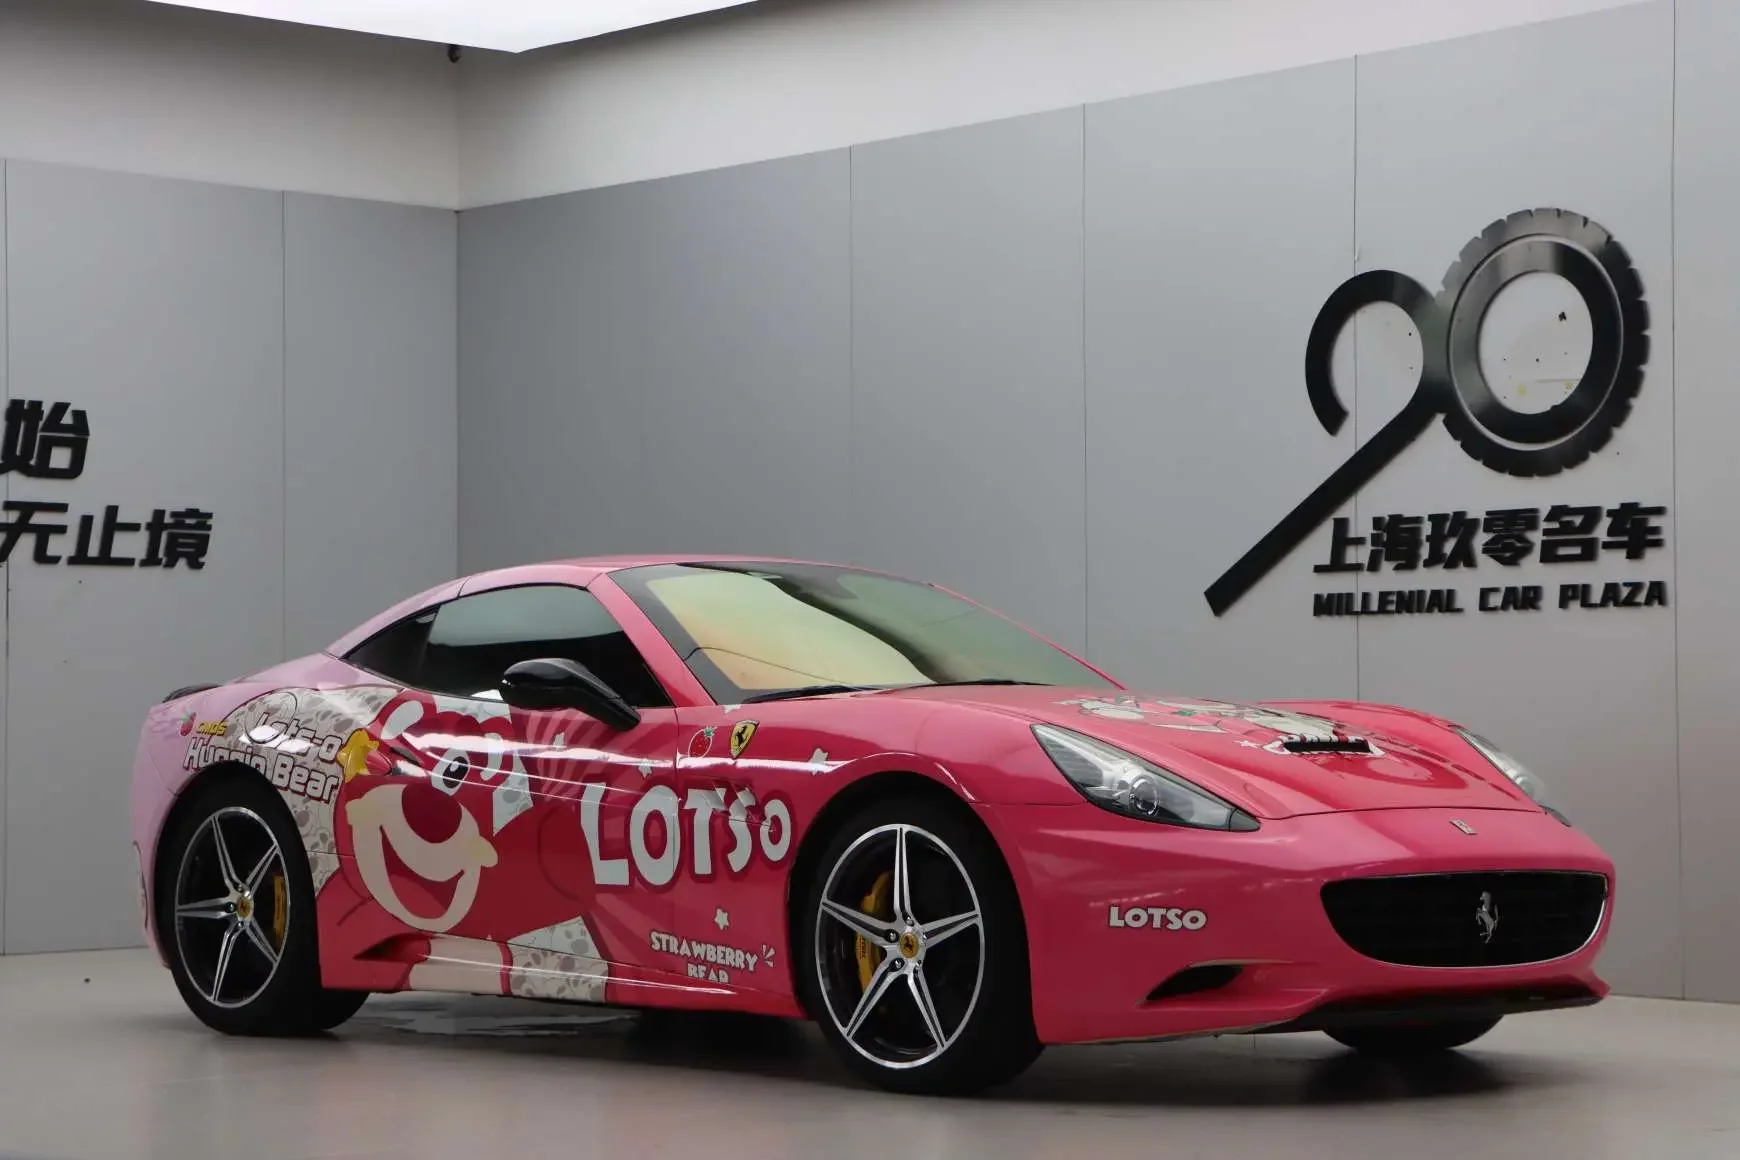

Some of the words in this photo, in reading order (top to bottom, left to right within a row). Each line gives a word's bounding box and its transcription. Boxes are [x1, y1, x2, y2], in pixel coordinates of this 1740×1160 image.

[0, 398, 90, 480] 始
[0, 500, 214, 571] 无止境
[1313, 501, 1668, 573] 上海玖零名车
[1312, 588, 1465, 617] MILLENIAL
[1478, 584, 1544, 613] CAR
[1558, 580, 1668, 610] PLAZA
[271, 752, 340, 804] Bear
[580, 781, 792, 887] LOTSO
[1108, 905, 1208, 931] LOTSO
[649, 930, 759, 972] STRAWBERRY
